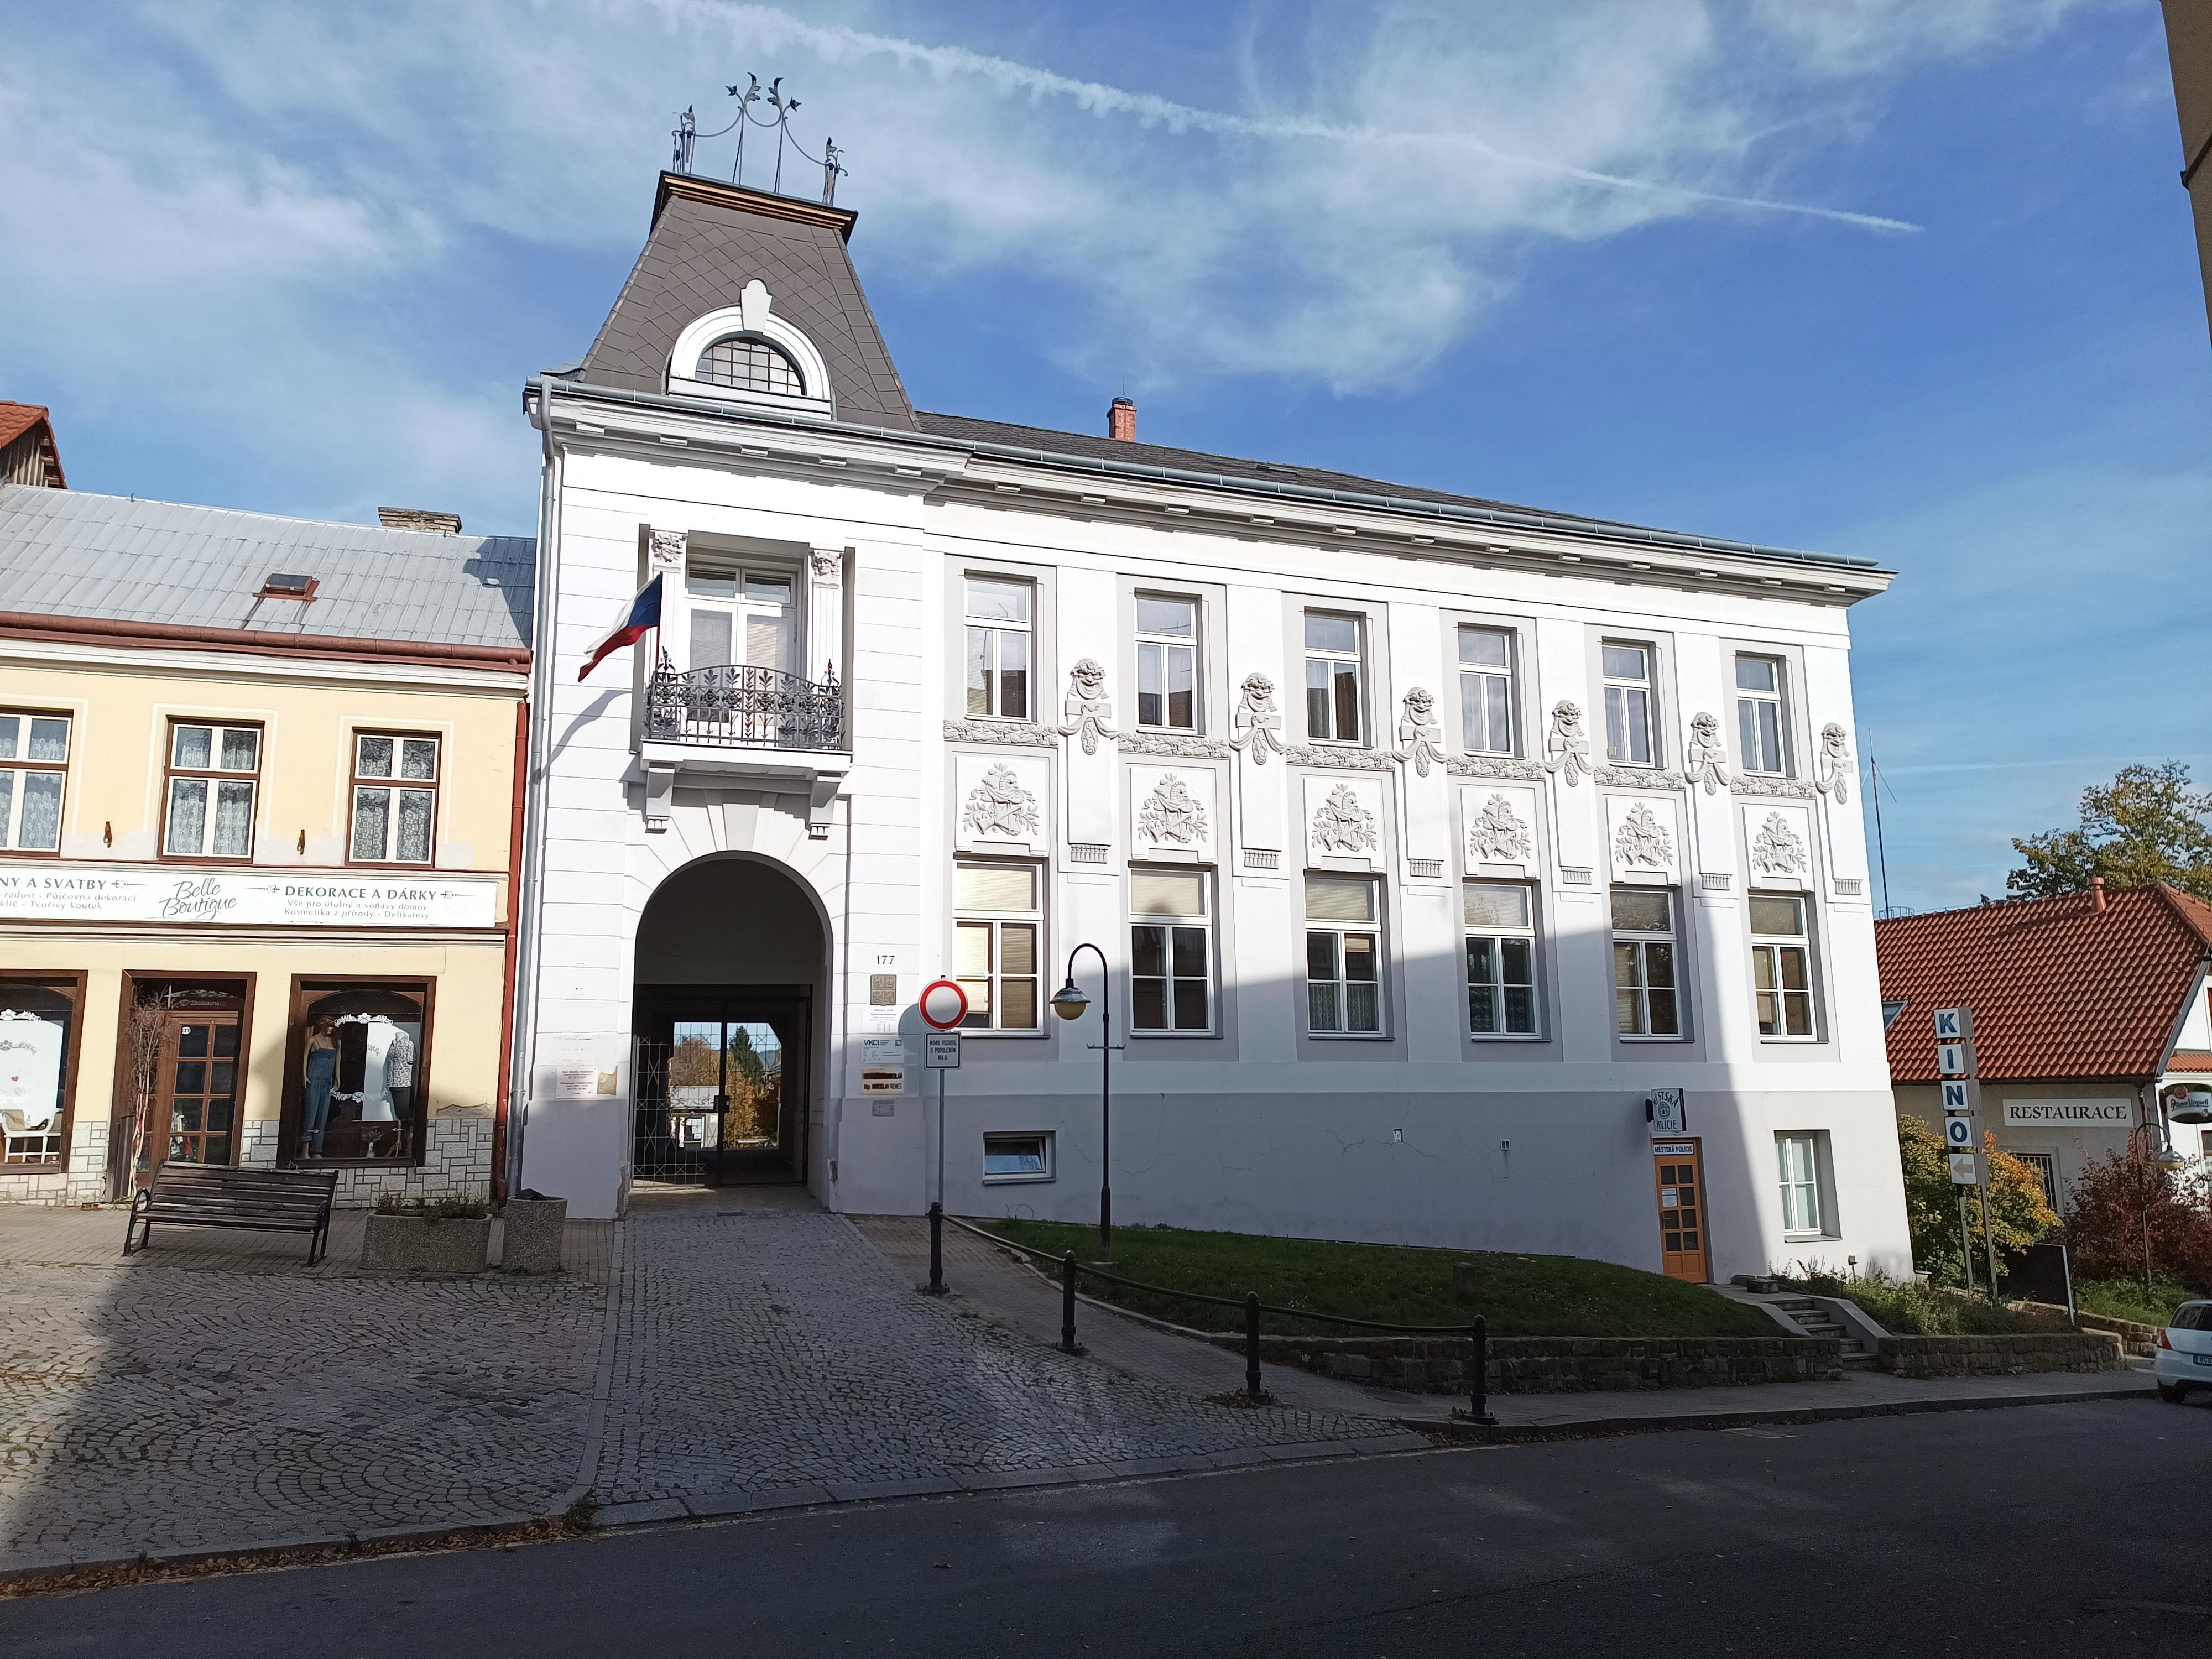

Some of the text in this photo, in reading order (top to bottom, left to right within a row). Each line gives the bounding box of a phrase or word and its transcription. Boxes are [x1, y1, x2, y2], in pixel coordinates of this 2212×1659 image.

[27, 878, 36, 888] A
[44, 878, 107, 890] SVATBY
[173, 878, 221, 901] Belle
[46, 892, 91, 901] Půjčovna
[95, 894, 137, 902] dekorací
[285, 886, 437, 900] DEKORACE A DÁRKY
[30, 901, 66, 910] Tvořivý
[70, 901, 102, 910] koutek
[159, 897, 237, 920] Boutique
[325, 900, 352, 909] útulný
[364, 902, 395, 910] voňavý
[285, 908, 330, 916] Kosmetika
[342, 909, 374, 918] přírody
[384, 911, 429, 920] Delikatesy
[876, 954, 895, 964] 177
[1939, 1013, 1968, 1142] KINO
[2009, 1106, 2127, 1119] RESTAURACE
[1656, 1120, 1677, 1130] POLICIE
